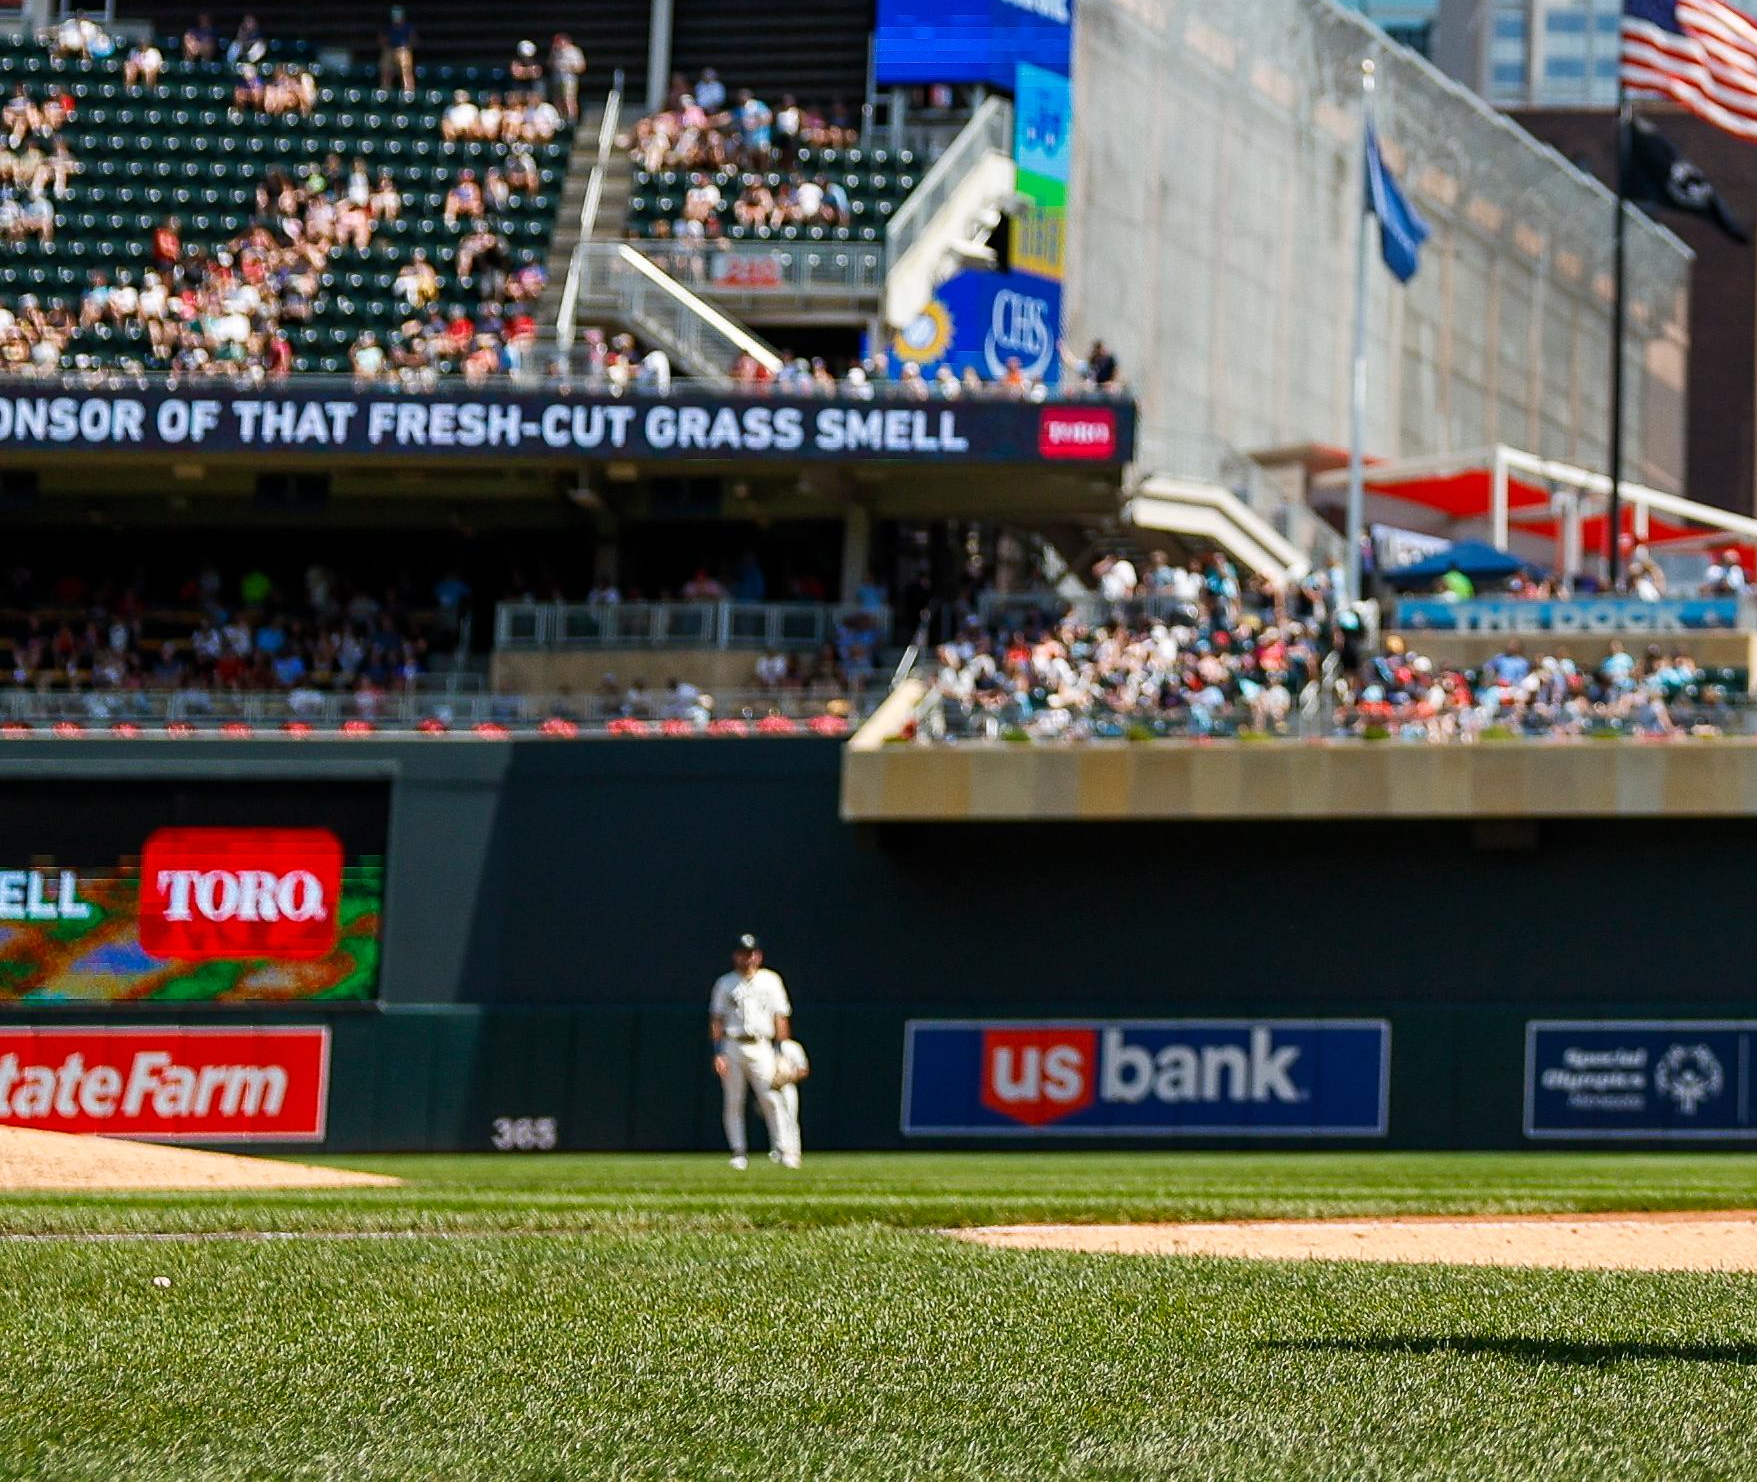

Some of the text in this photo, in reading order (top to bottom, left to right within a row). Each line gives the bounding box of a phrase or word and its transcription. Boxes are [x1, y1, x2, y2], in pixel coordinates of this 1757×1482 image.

[157, 398, 221, 443] OF
[233, 399, 358, 445] THAT
[369, 401, 635, 448] FRESH-CUT
[645, 405, 804, 450] GRASS
[816, 406, 969, 453] SMELL
[1450, 603, 1543, 633] THE
[157, 869, 327, 922] TORO
[991, 1028, 1300, 1104] us bank
